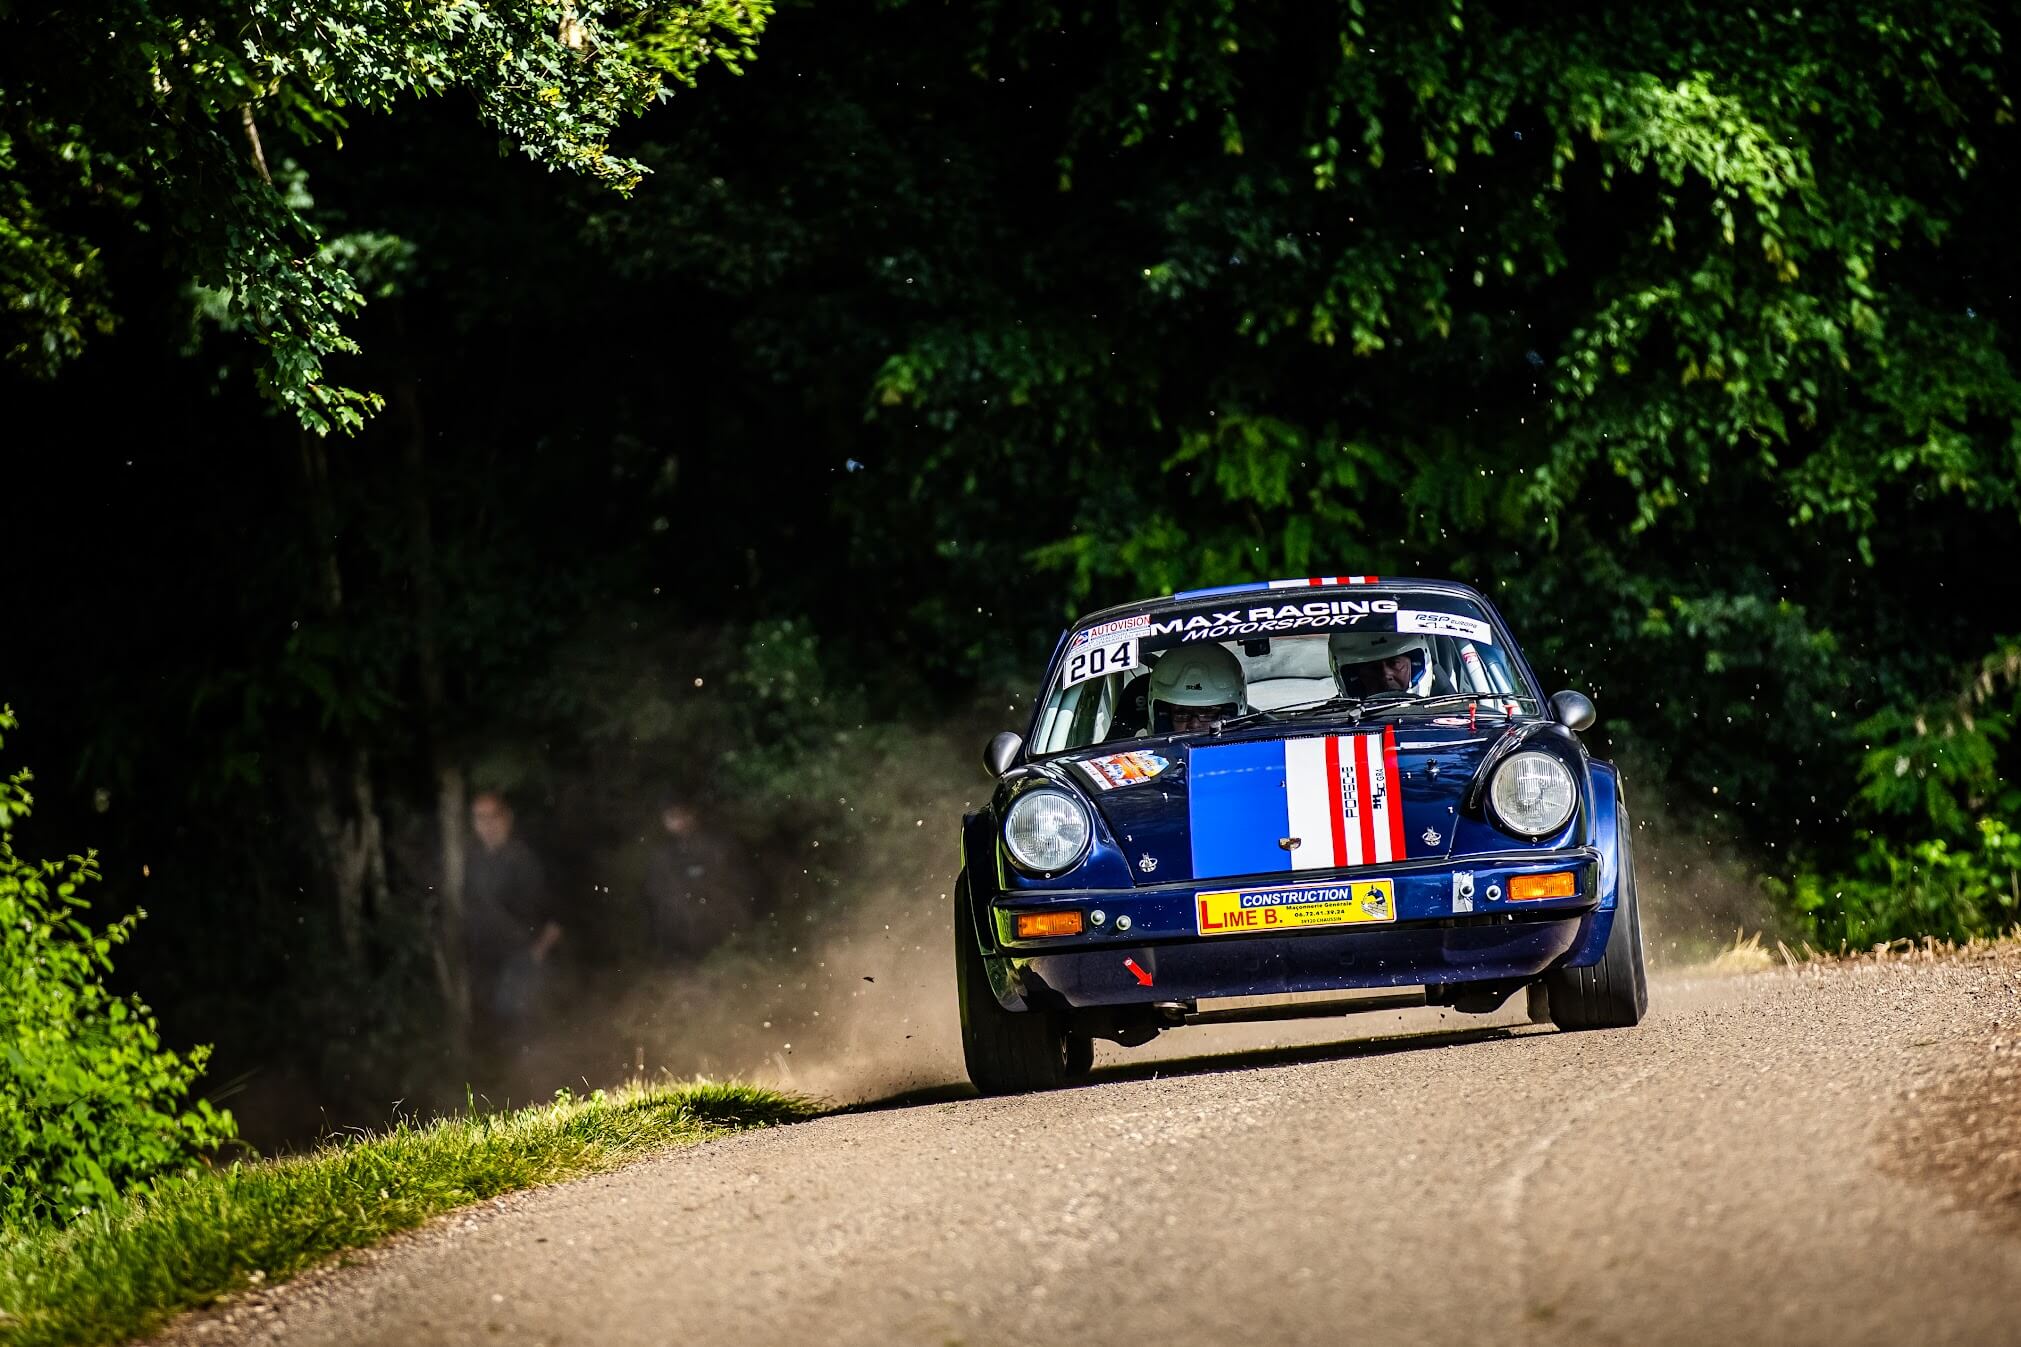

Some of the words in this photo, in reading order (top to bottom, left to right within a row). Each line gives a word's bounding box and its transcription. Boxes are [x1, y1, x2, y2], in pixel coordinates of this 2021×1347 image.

[1091, 615, 1151, 637] AUTOVISION
[1150, 610, 1241, 637] MAX
[1248, 600, 1399, 622] RACING
[1181, 614, 1368, 642] MOTORSPORT
[1415, 614, 1450, 622] RSP
[1071, 642, 1130, 683] 204
[1242, 888, 1349, 907] CONSTRUCTION
[1201, 900, 1258, 930] LIME
[1264, 908, 1283, 925] B.
